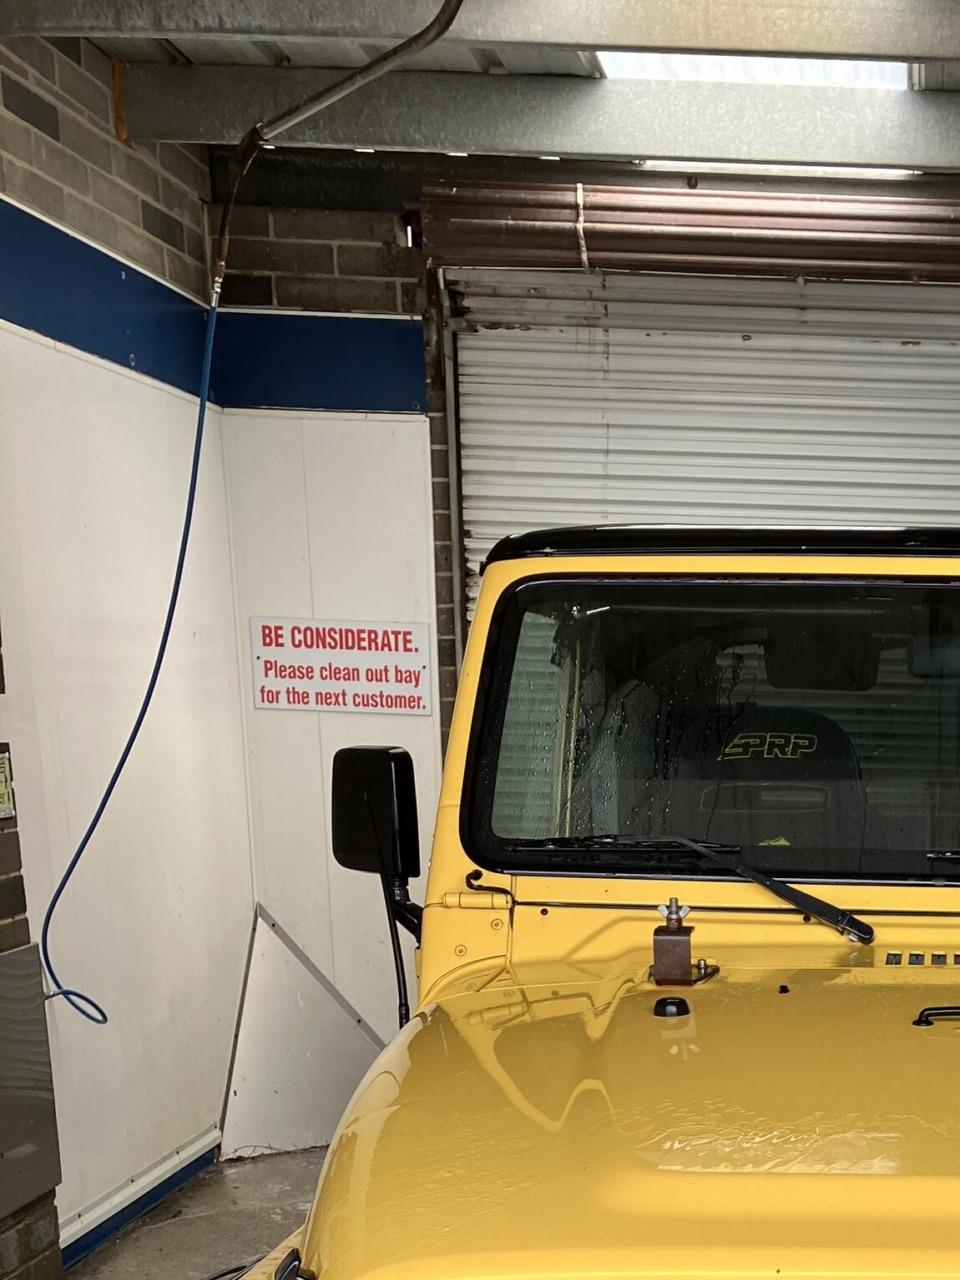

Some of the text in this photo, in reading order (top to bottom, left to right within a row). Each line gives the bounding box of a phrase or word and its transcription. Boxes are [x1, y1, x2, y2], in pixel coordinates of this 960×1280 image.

[261, 625, 419, 652] BE CONSIDERATE.
[263, 660, 421, 688] Please clean out bay
[260, 685, 426, 710] for the next customer.
[717, 733, 818, 760] PRP
